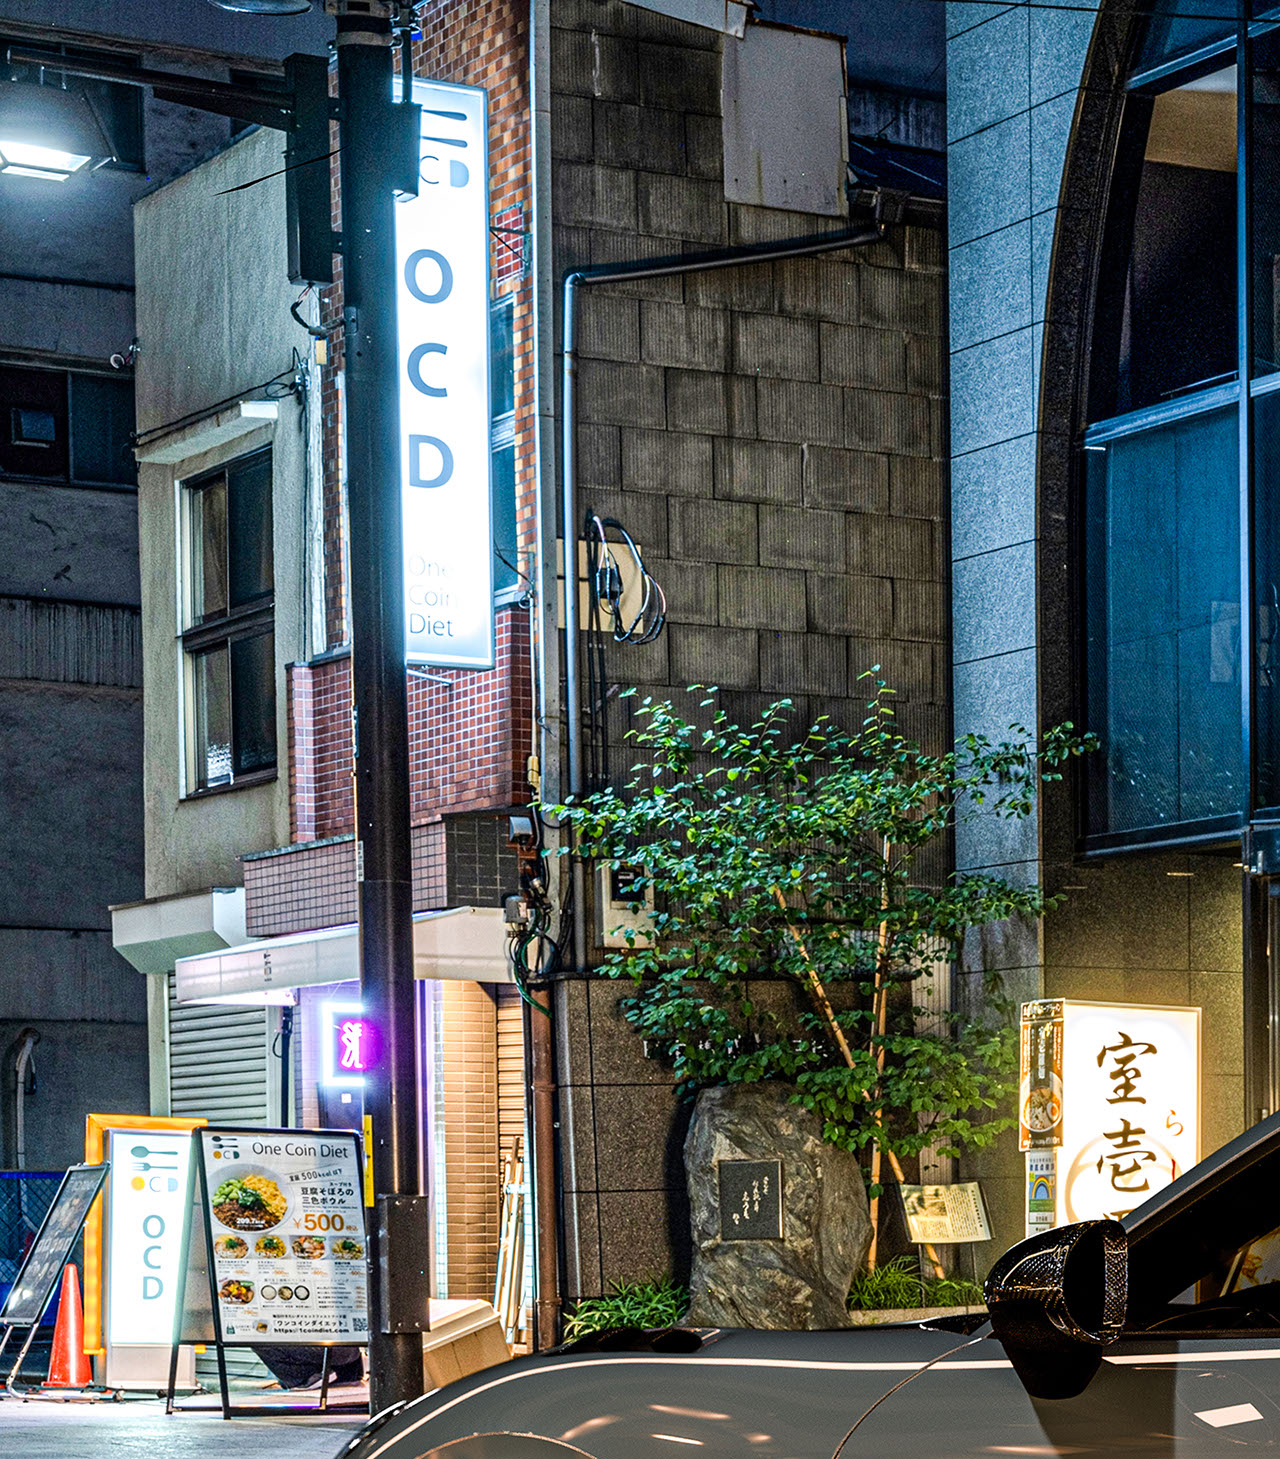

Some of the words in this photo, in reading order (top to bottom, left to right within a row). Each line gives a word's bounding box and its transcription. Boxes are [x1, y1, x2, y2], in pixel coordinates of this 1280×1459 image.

[409, 613, 454, 637] Diet
[252, 1142, 282, 1155] One
[285, 1143, 316, 1157] Coin
[320, 1145, 349, 1159] Diet
[301, 1187, 354, 1197] 豆腐そぼろの
[302, 1196, 346, 1206] 三色ボウル
